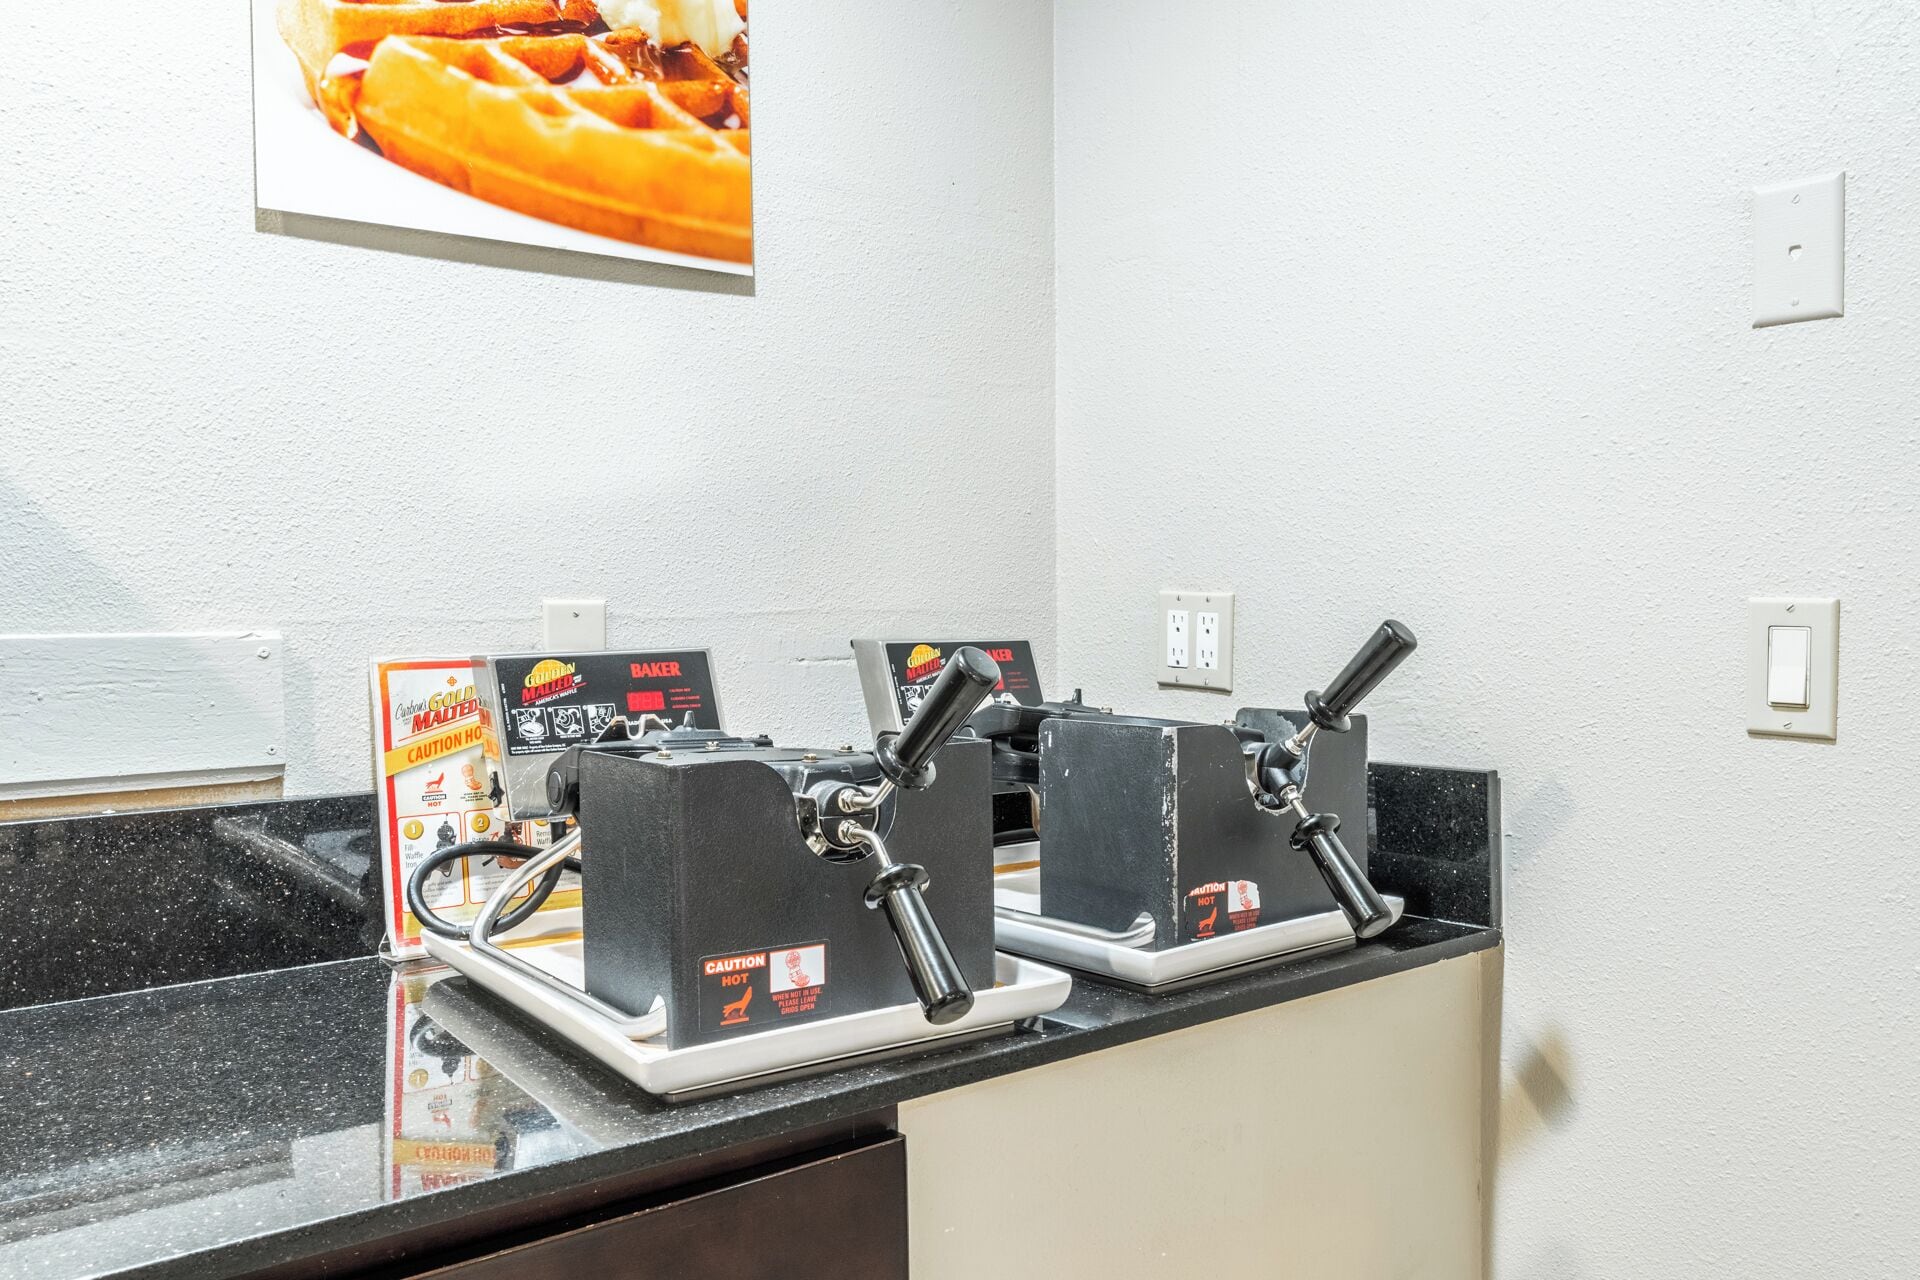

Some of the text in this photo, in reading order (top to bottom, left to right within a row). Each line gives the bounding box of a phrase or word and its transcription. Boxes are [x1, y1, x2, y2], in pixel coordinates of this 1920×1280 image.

[986, 648, 1014, 662] KER
[524, 662, 576, 688] GOLDEN
[630, 661, 682, 679] BAKER
[906, 657, 940, 682] MALTED
[521, 674, 574, 702] MALTED
[428, 684, 477, 711] GOLD
[411, 698, 479, 734] MALTED
[407, 731, 462, 763] CAUTION
[465, 725, 482, 744] HO
[405, 852, 424, 860] Waffle
[1198, 896, 1215, 906] HOT
[705, 955, 766, 974] CAUTION
[721, 972, 749, 987] HOT
[772, 992, 789, 1001] WHEN
[790, 990, 801, 998] NOT
[778, 995, 817, 1008] PLEASE LEAVE
[781, 1002, 815, 1015] GRIDS OPEN
